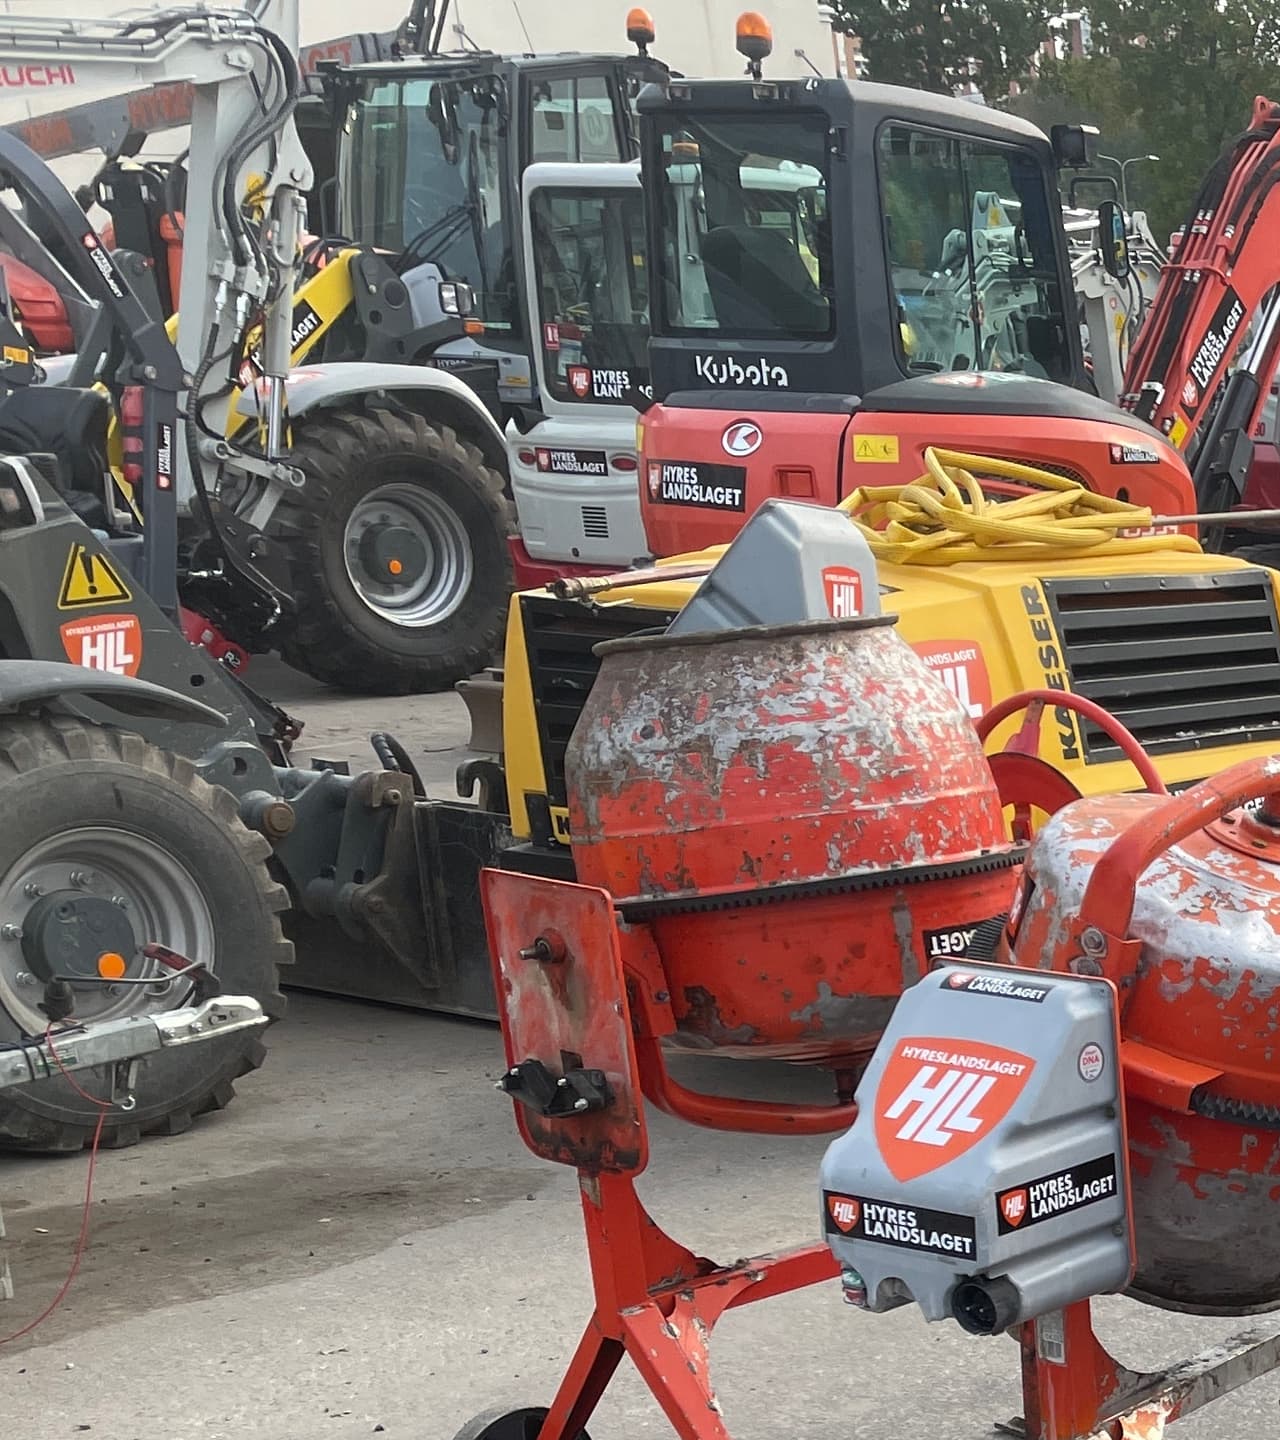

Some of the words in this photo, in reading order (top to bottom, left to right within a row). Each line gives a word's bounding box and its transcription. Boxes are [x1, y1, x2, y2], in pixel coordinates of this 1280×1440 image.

[0, 64, 76, 87] UCHI
[289, 311, 322, 352] LAGET
[1198, 300, 1245, 390] LANDSLAGET
[1190, 331, 1218, 376] HYRES
[592, 369, 629, 386] HYRES
[695, 355, 789, 388] Kubota
[551, 452, 577, 463] HYRES
[551, 460, 606, 474] LANDSLAGET
[663, 464, 698, 485] HYRES
[662, 482, 742, 506] LANDSLAGET
[923, 648, 977, 667] ANDSLAGET
[1020, 584, 1080, 760] KAESER
[930, 928, 978, 956] AGET
[967, 981, 1046, 1000] LANDSLAGET
[901, 1045, 1026, 1077] HYRESLANDSLAGET
[1082, 1055, 1101, 1067] DNA
[883, 1065, 998, 1147] HLL
[1029, 1173, 1073, 1203] HYRES
[1030, 1174, 1115, 1219] LANDSLAGET
[863, 1202, 917, 1228] HYRES
[863, 1218, 973, 1254] LANDSLAGET
